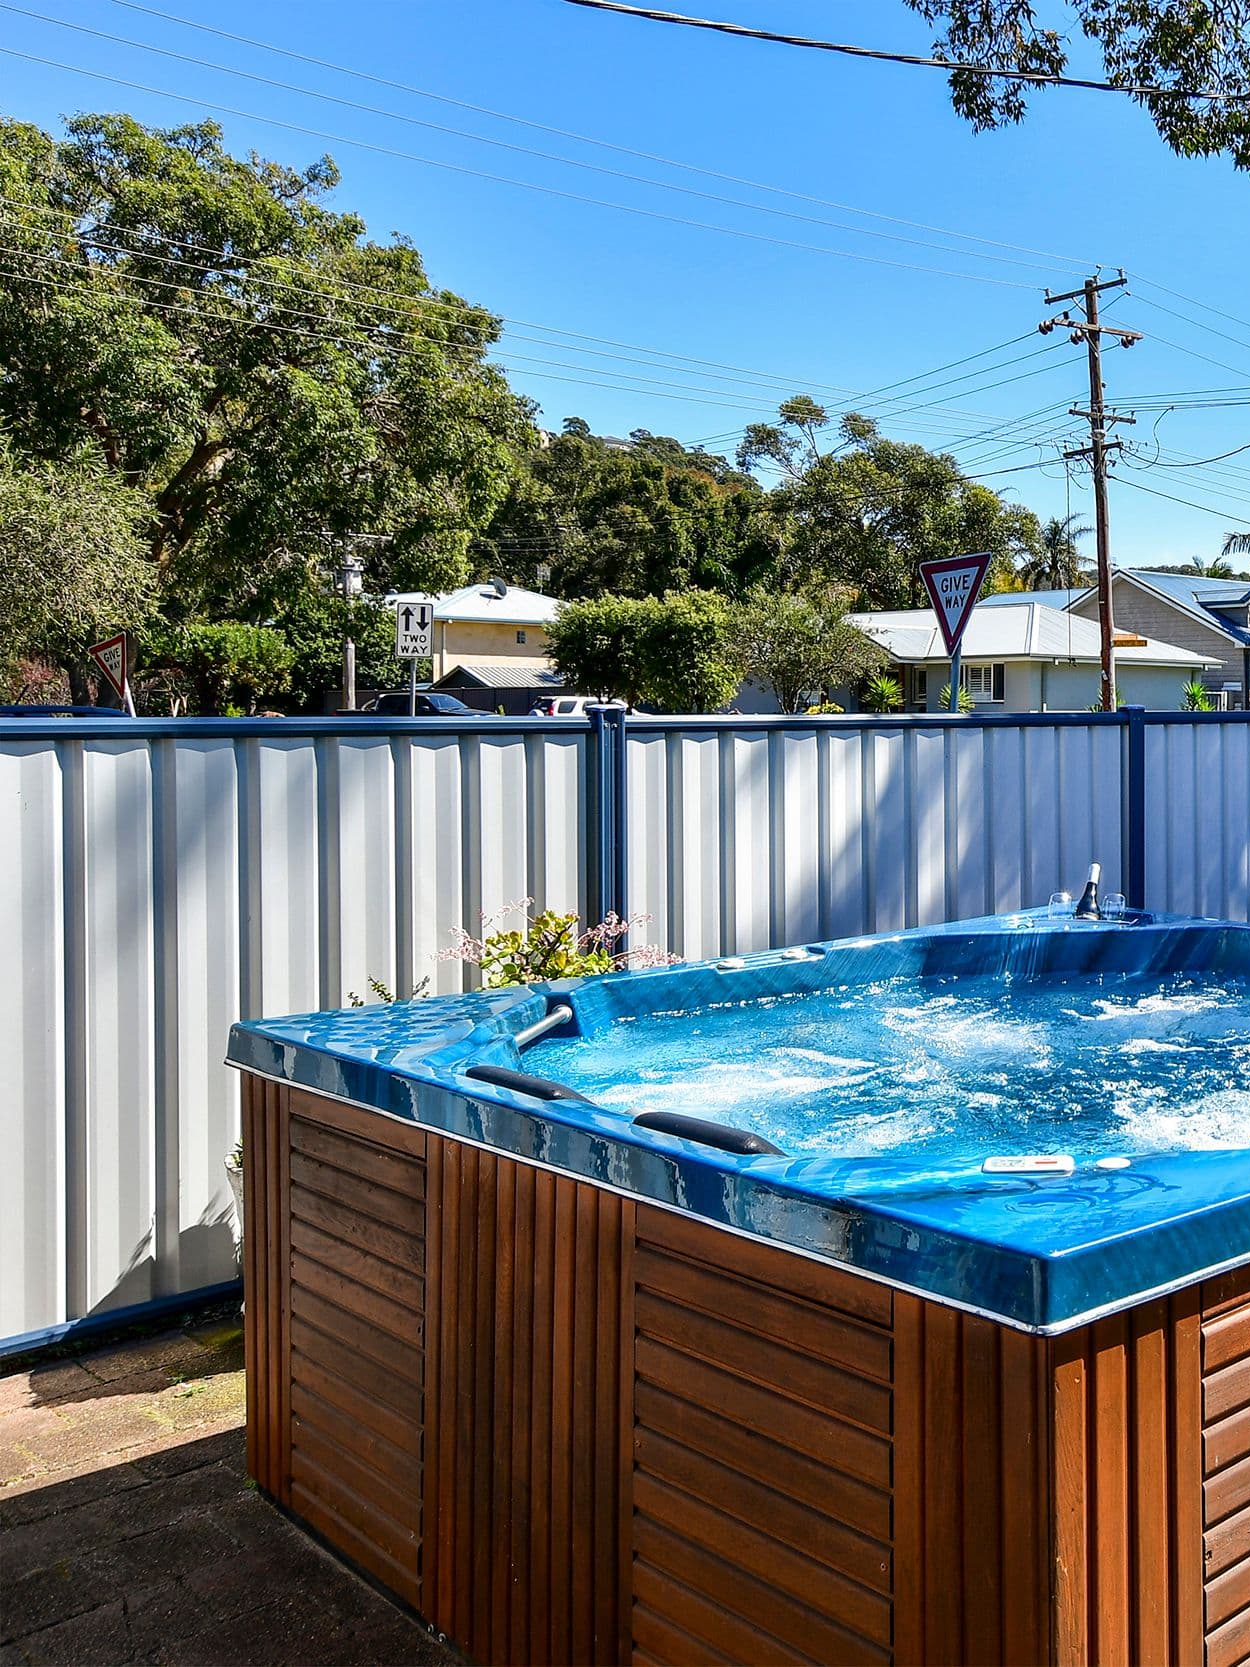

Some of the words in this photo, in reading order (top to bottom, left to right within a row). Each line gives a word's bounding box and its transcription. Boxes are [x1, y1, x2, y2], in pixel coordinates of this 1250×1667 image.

[941, 574, 970, 593] GIVE
[945, 594, 966, 609] WAY
[403, 634, 427, 643] TWO
[104, 647, 121, 663] GIVE
[401, 645, 428, 654] WAY
